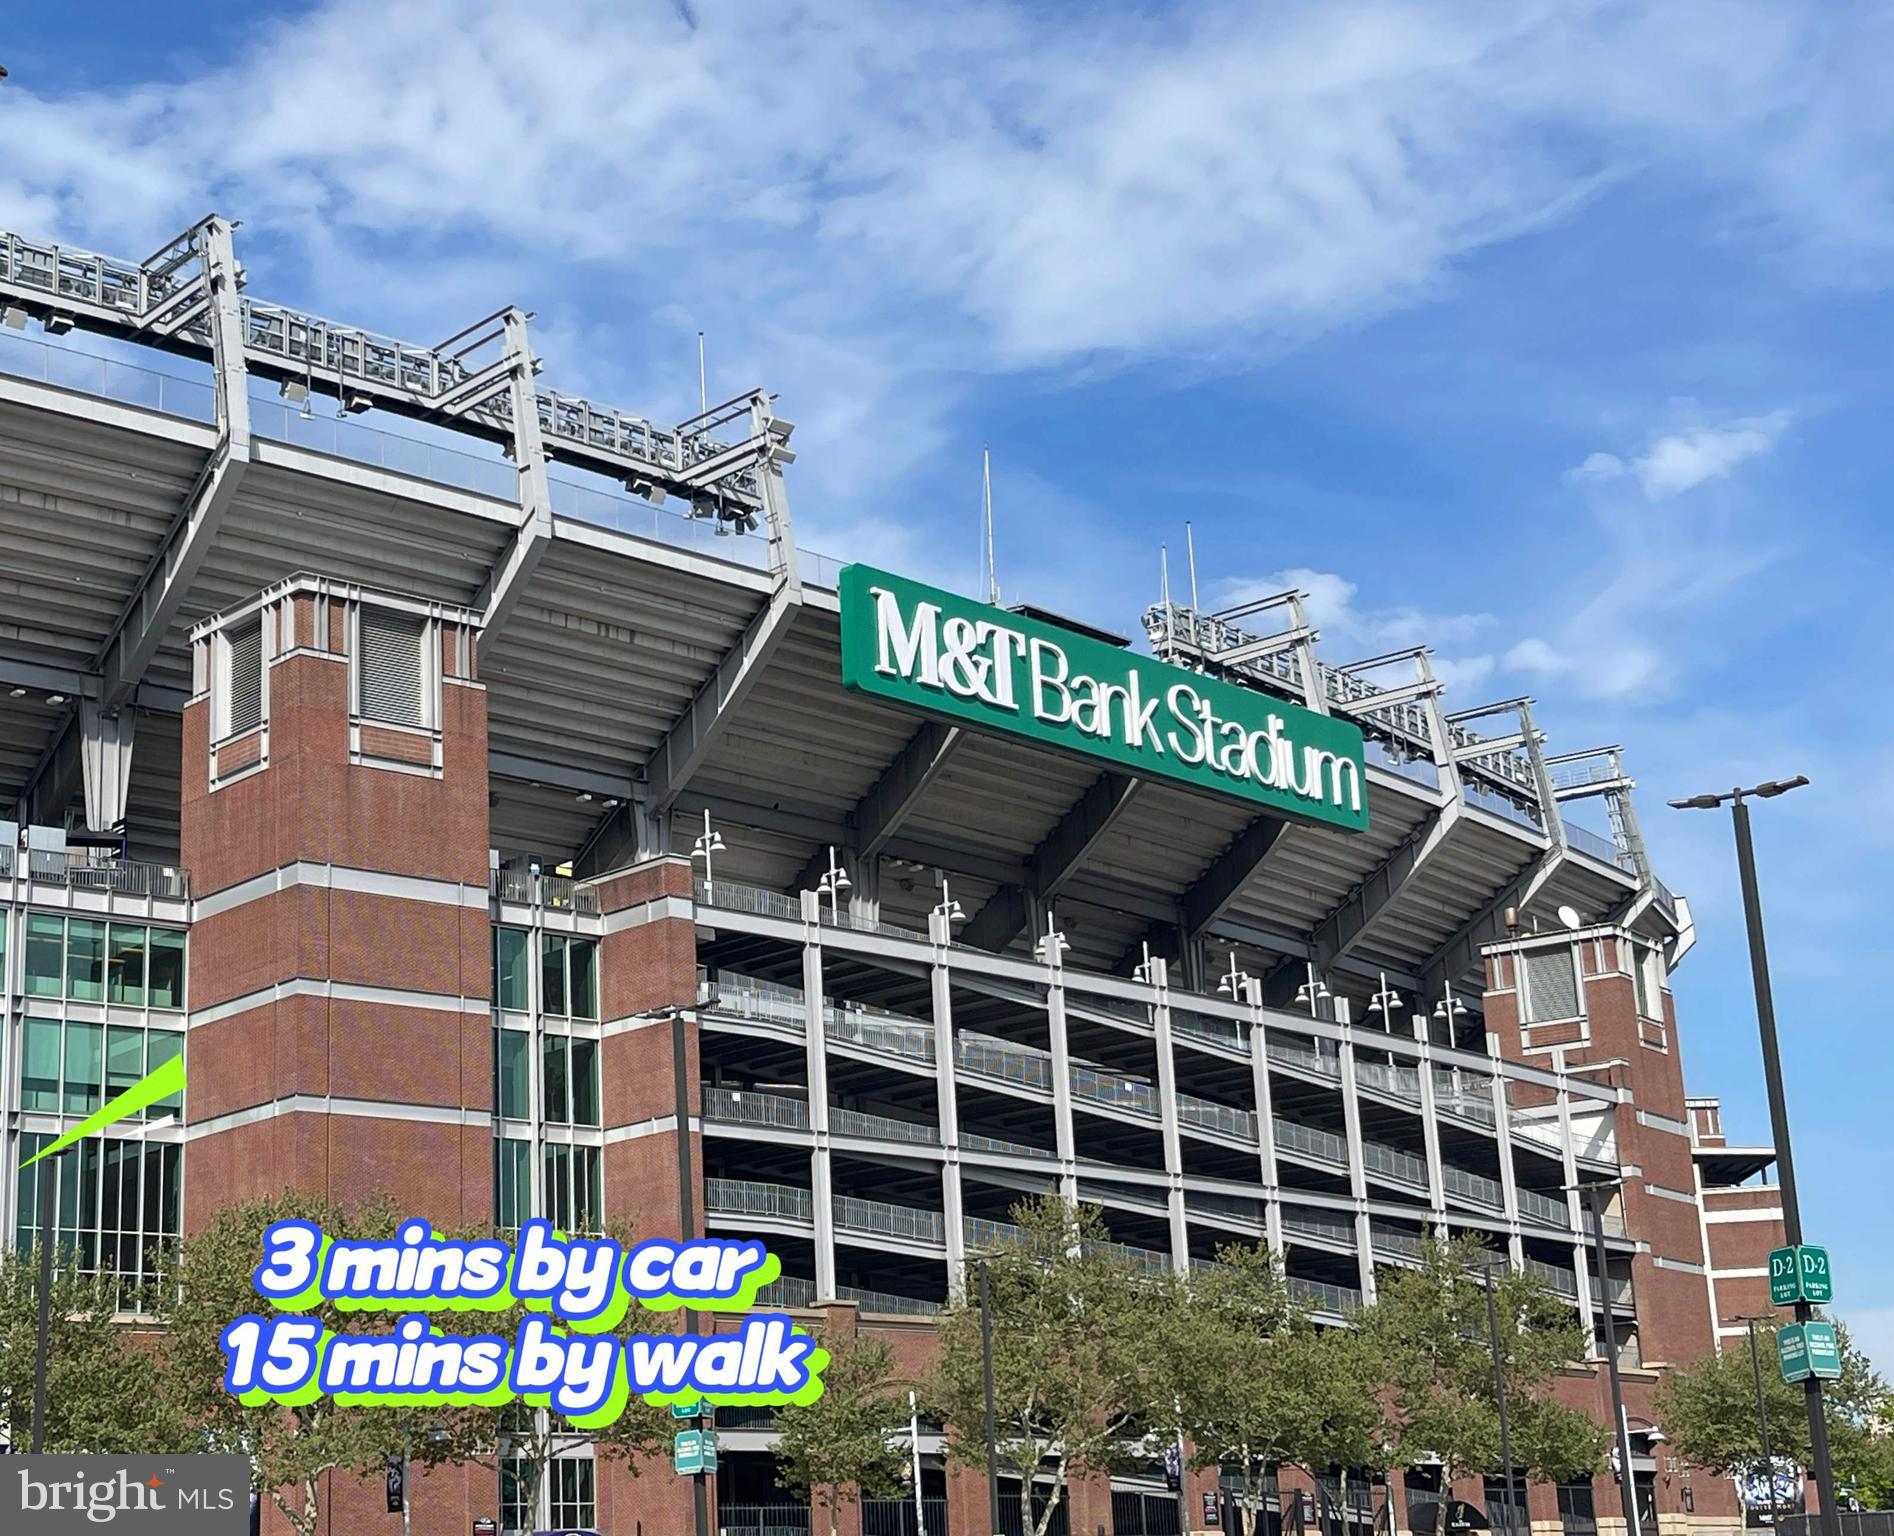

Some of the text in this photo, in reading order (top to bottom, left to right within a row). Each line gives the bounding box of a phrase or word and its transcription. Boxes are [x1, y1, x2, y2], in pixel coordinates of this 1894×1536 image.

[868, 586, 1362, 812] M&T Bank Stadium
